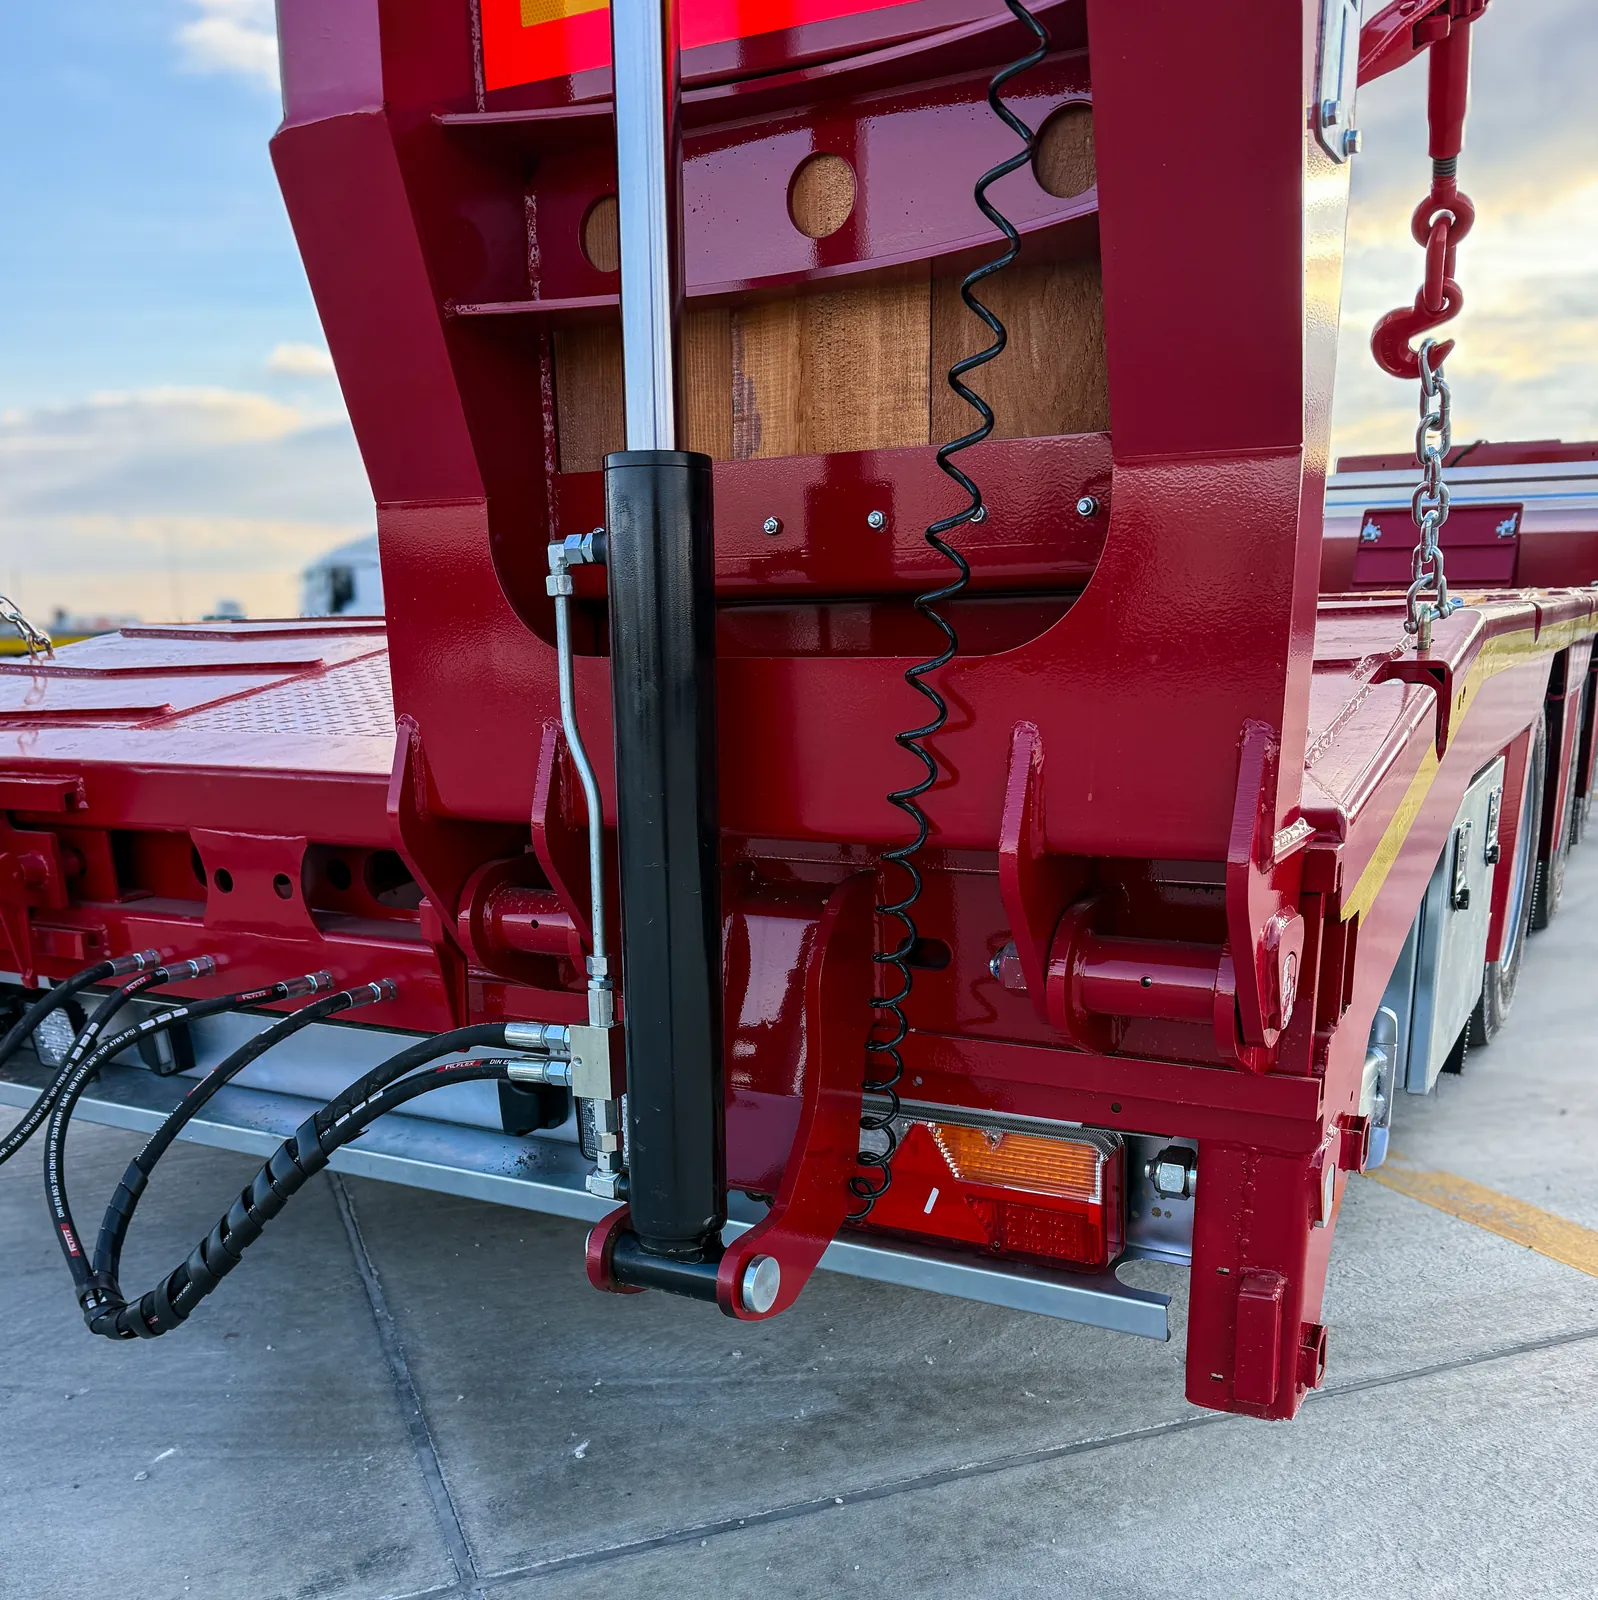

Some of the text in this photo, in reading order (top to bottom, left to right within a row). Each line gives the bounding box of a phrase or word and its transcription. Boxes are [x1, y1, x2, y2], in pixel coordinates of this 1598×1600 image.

[123, 1028, 136, 1038] PSI
[109, 1035, 125, 1047] 4785
[97, 1045, 109, 1055] WP
[75, 1066, 89, 1082] R2AT
[67, 1081, 77, 1092] 100
[20, 1124, 32, 1135] 100
[29, 1109, 43, 1125] R2AT
[48, 1087, 58, 1098] WP
[64, 1062, 74, 1074] PSI
[56, 1111, 64, 1127] BAR
[51, 1128, 59, 1140] 330
[50, 1141, 57, 1151] WP
[49, 1152, 57, 1169] DN10
[54, 1197, 63, 1207] EN
[57, 1208, 65, 1218] DIN
